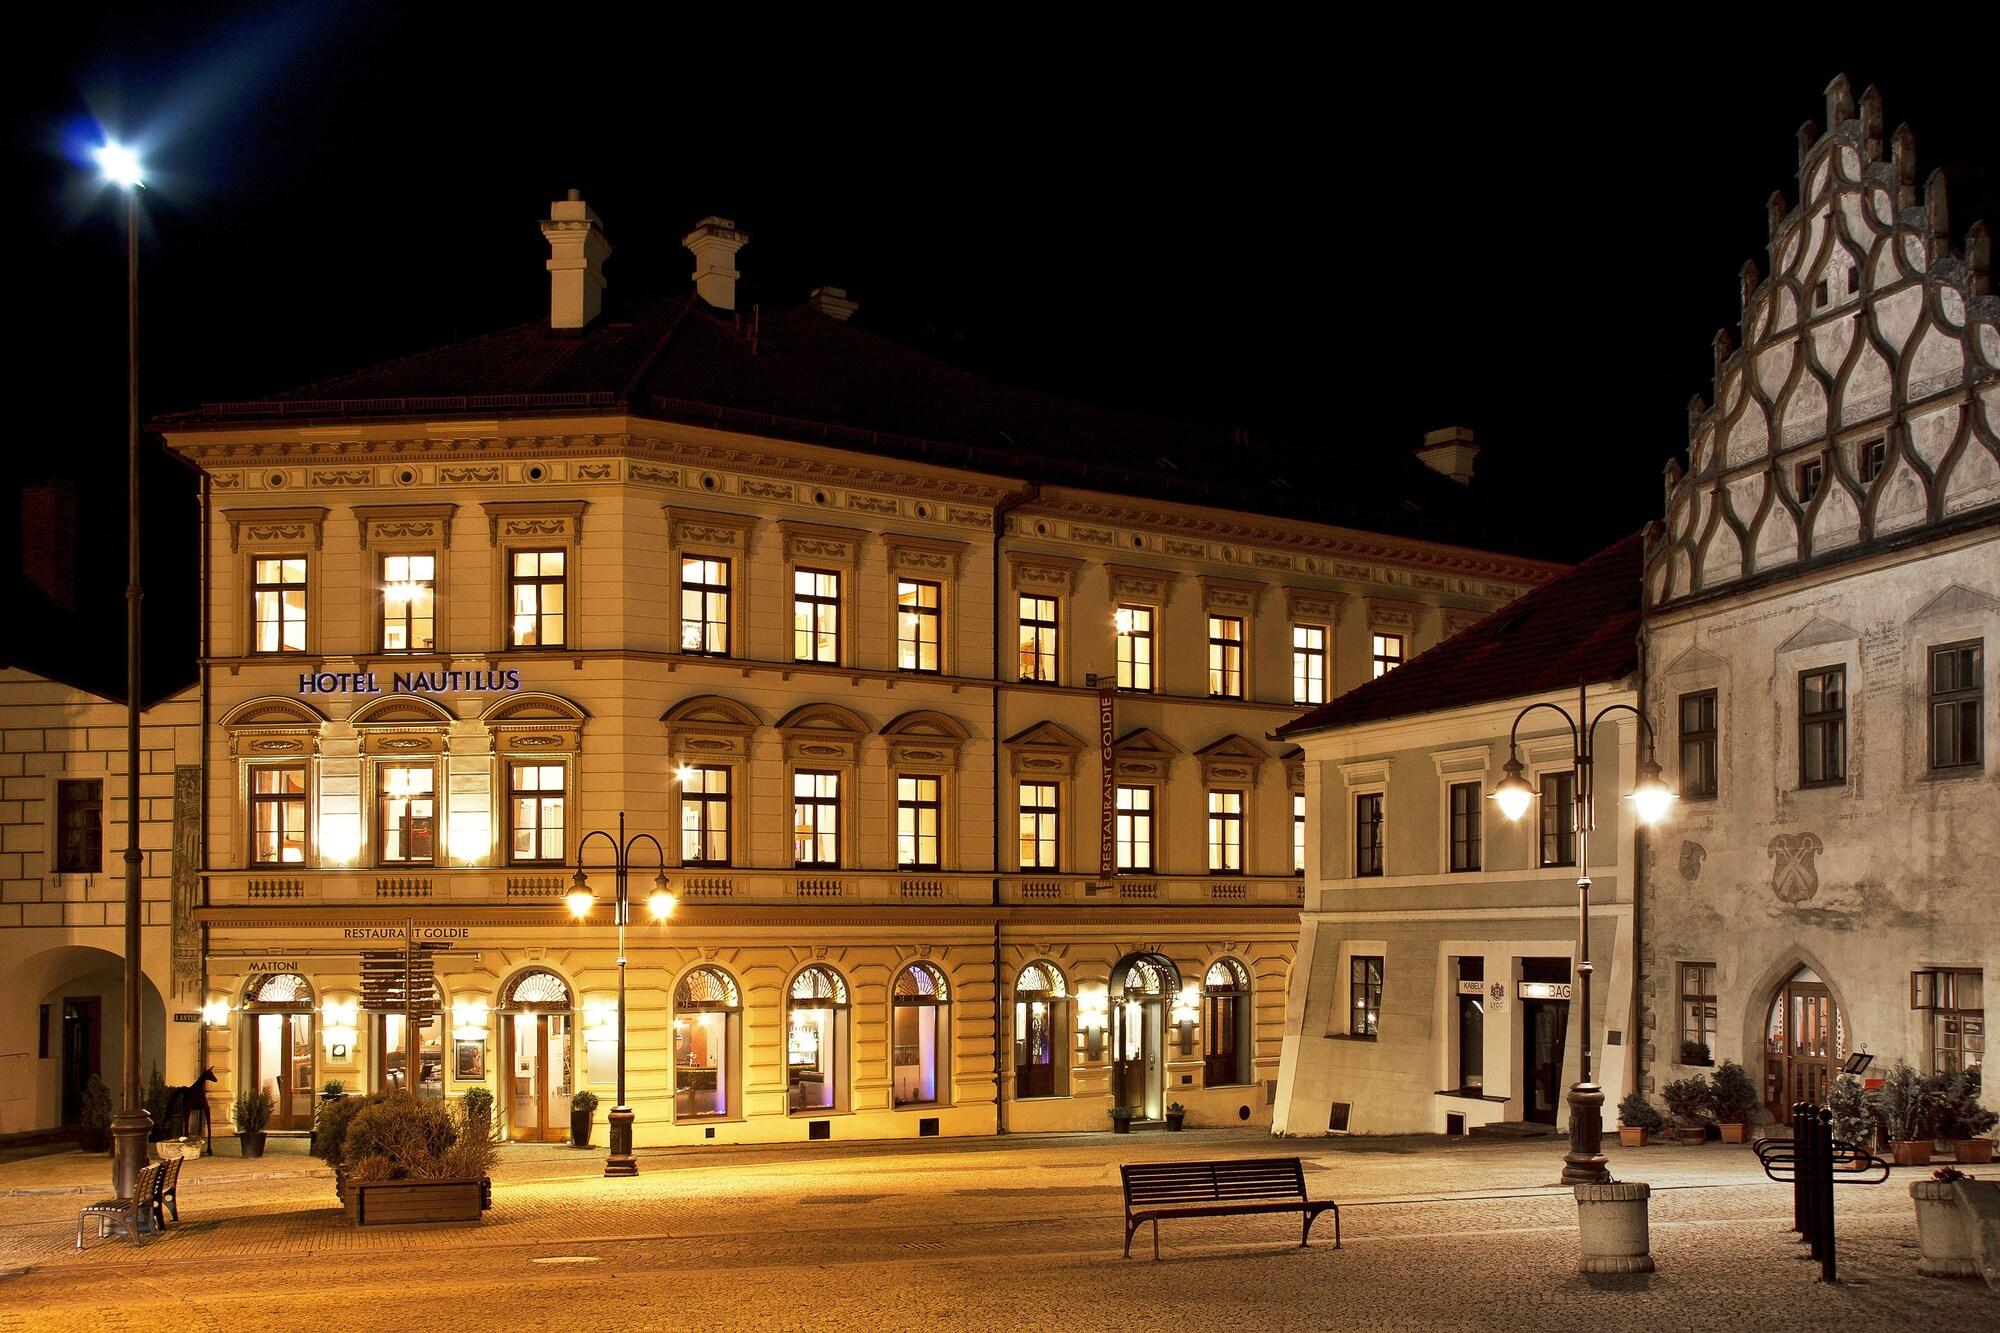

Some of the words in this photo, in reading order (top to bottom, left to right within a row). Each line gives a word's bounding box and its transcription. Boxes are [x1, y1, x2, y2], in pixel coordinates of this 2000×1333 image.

[299, 672, 380, 694] HOTEL
[393, 669, 520, 693] NAUTILUS
[1102, 697, 1112, 761] GOLDIE
[1102, 766, 1112, 871] RESTAURANT
[344, 928, 422, 938] RESTAURAT
[424, 928, 469, 938] GOLDIE
[248, 961, 298, 971] MATTONI
[1548, 984, 1571, 998] BAG
